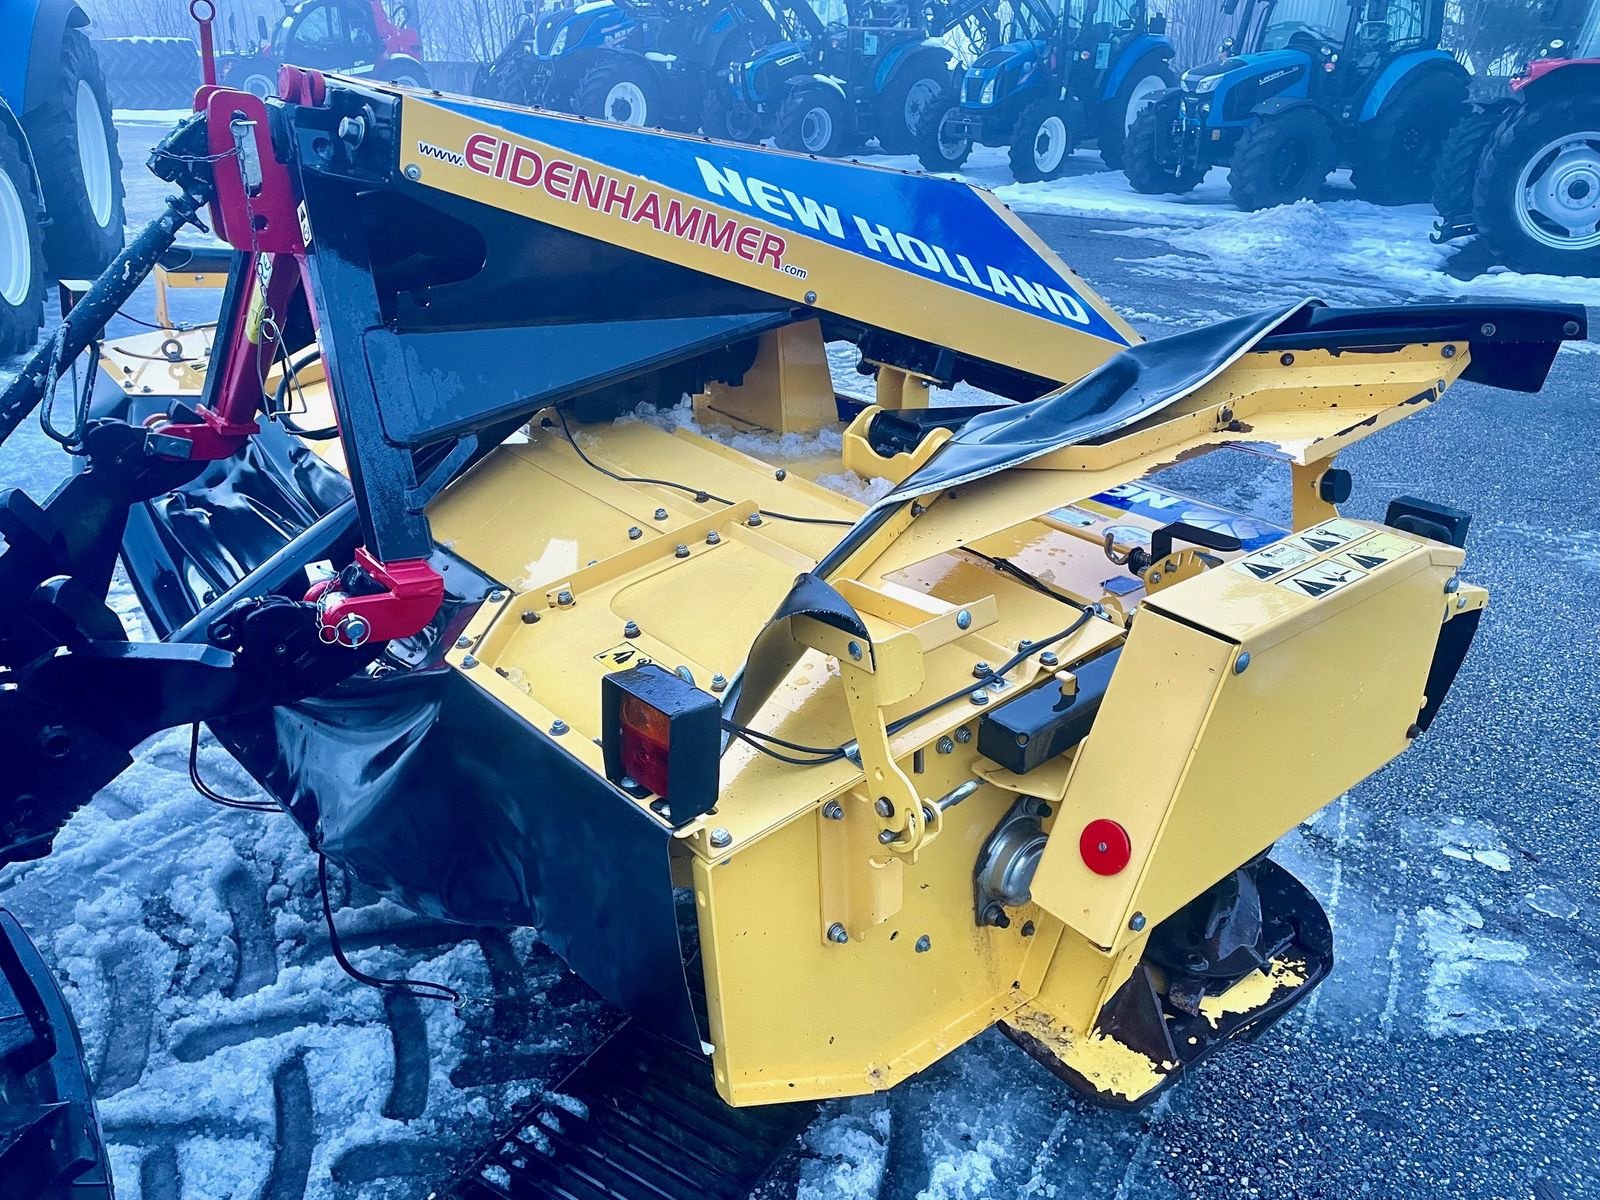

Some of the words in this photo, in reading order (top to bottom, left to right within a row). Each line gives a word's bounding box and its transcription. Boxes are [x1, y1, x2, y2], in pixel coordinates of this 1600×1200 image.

[418, 133, 807, 279] www.EIDENHAMMER.com
[695, 156, 846, 240] NEW
[853, 214, 1091, 326] HOLLAND
